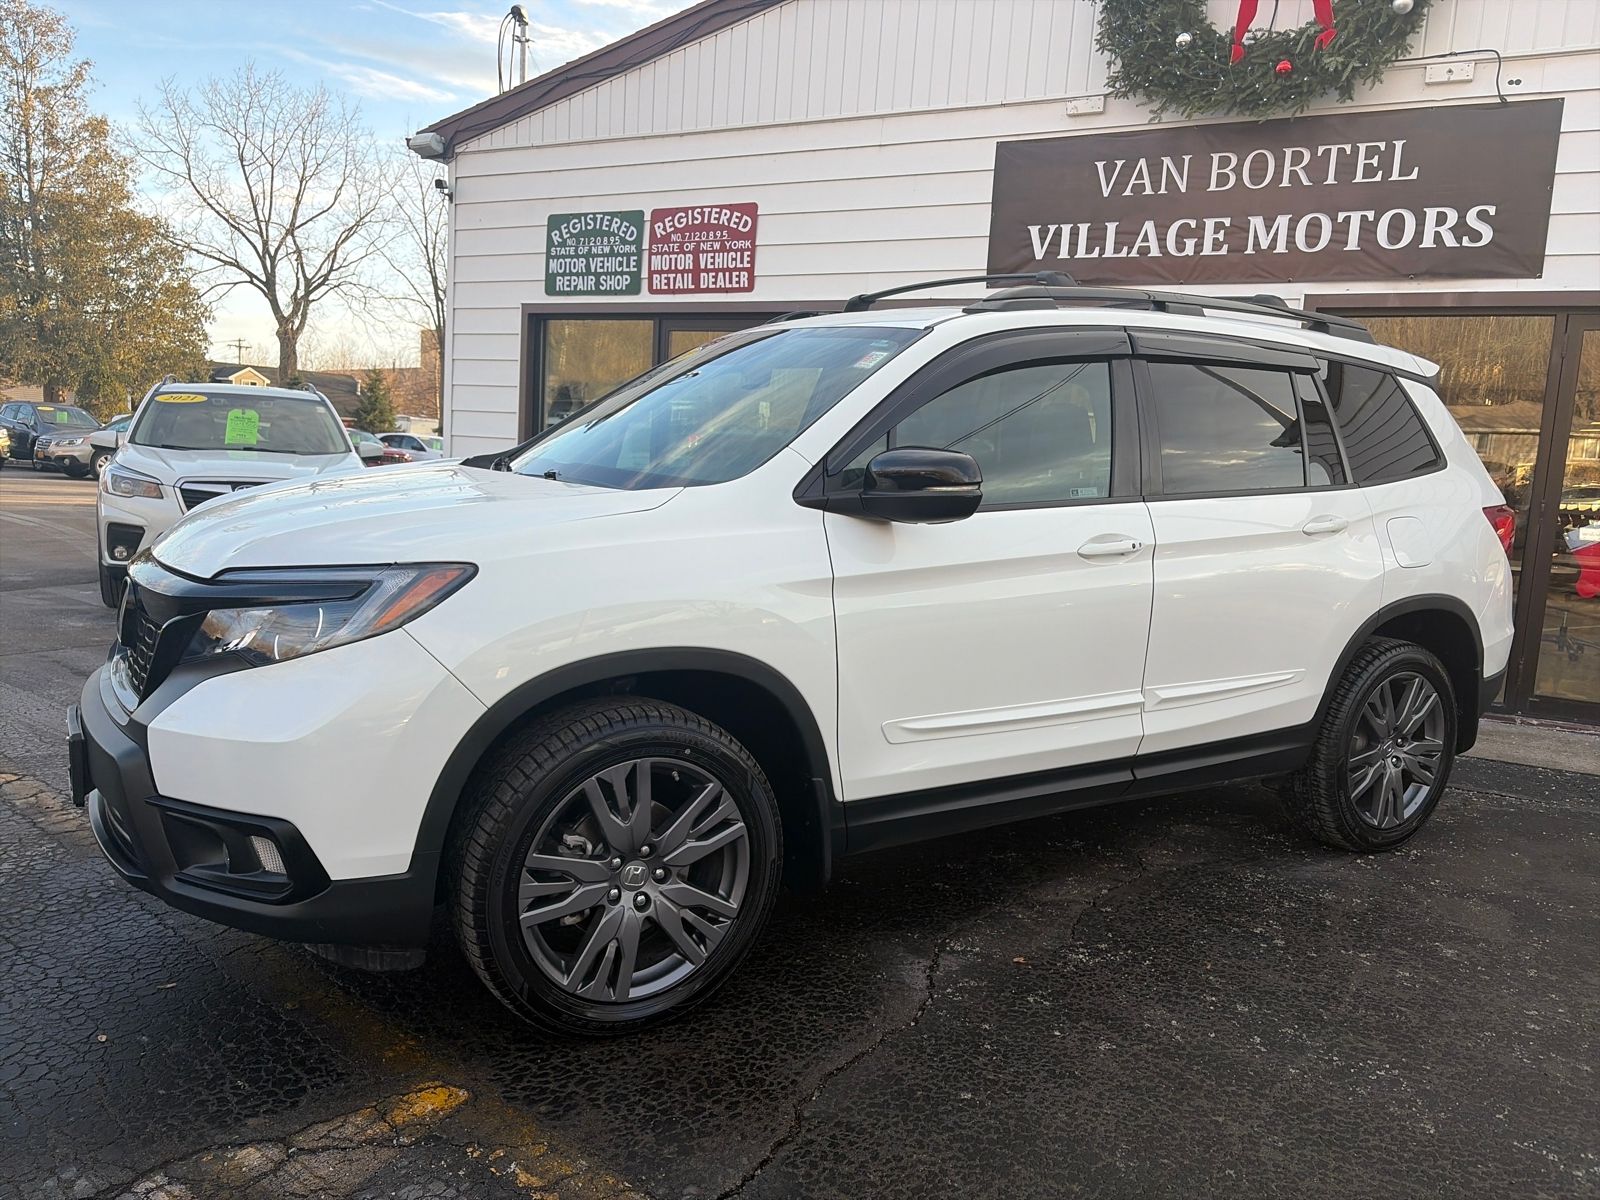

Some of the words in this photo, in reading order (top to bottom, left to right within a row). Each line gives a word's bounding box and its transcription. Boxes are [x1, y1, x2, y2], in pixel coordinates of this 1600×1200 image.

[1094, 155, 1192, 198] VAN
[1207, 139, 1421, 192] BORTEL
[551, 214, 637, 245] REGISTERED
[654, 207, 752, 239] REGISTERED
[579, 236, 621, 246] 7120895
[684, 230, 728, 240] 7120895
[1027, 216, 1231, 261] VILLAGE
[1244, 204, 1498, 256] MOTORS
[550, 247, 575, 256] STATE
[578, 246, 589, 255] OF
[591, 246, 610, 254] NEW
[613, 245, 637, 253] YORK
[651, 243, 680, 253] STATE
[683, 243, 696, 252] OF
[700, 242, 721, 251] NEW
[724, 240, 752, 250] YORK
[549, 258, 586, 274] MOTOR
[589, 256, 637, 273] VEHICLE
[651, 254, 693, 271] MOTOR
[699, 251, 751, 269] VEHICLE
[556, 276, 595, 291] REPAIR
[599, 275, 631, 291] SHOP
[653, 273, 695, 290] RETAIL
[700, 271, 749, 289] DEALER
